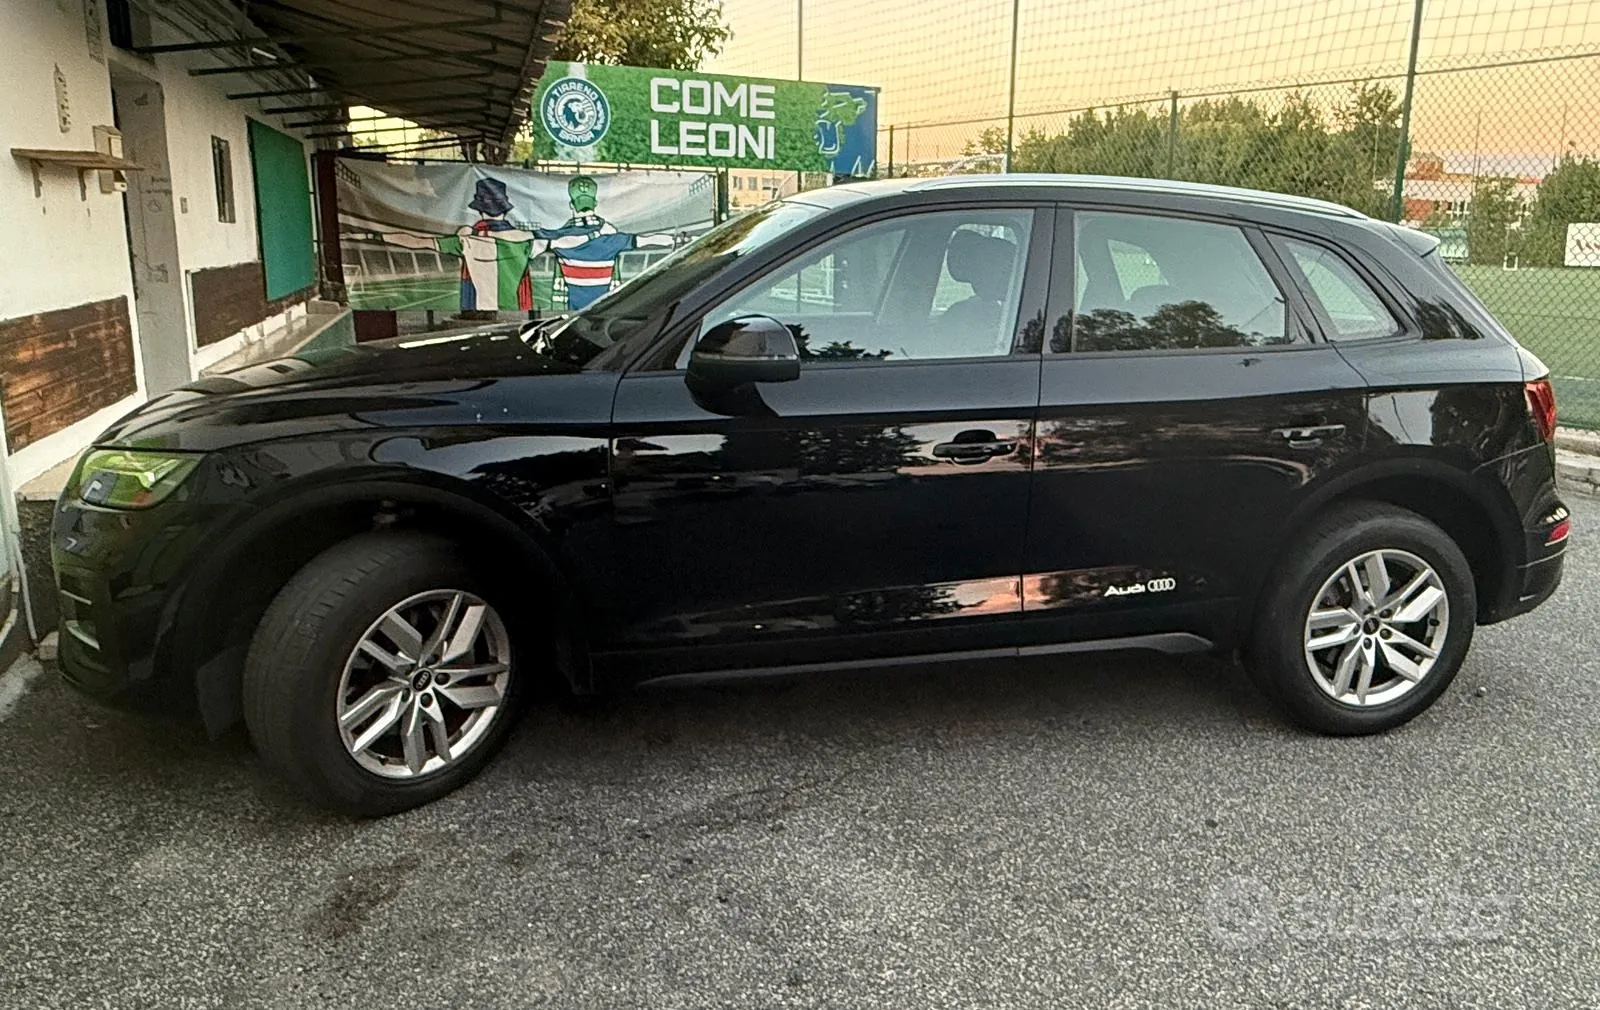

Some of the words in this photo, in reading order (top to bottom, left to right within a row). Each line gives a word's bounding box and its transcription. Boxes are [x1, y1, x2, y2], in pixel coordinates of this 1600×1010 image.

[551, 81, 599, 101] TIRRENO
[650, 77, 775, 119] COME
[650, 119, 775, 160] LEONI
[1104, 583, 1145, 597] Audi
